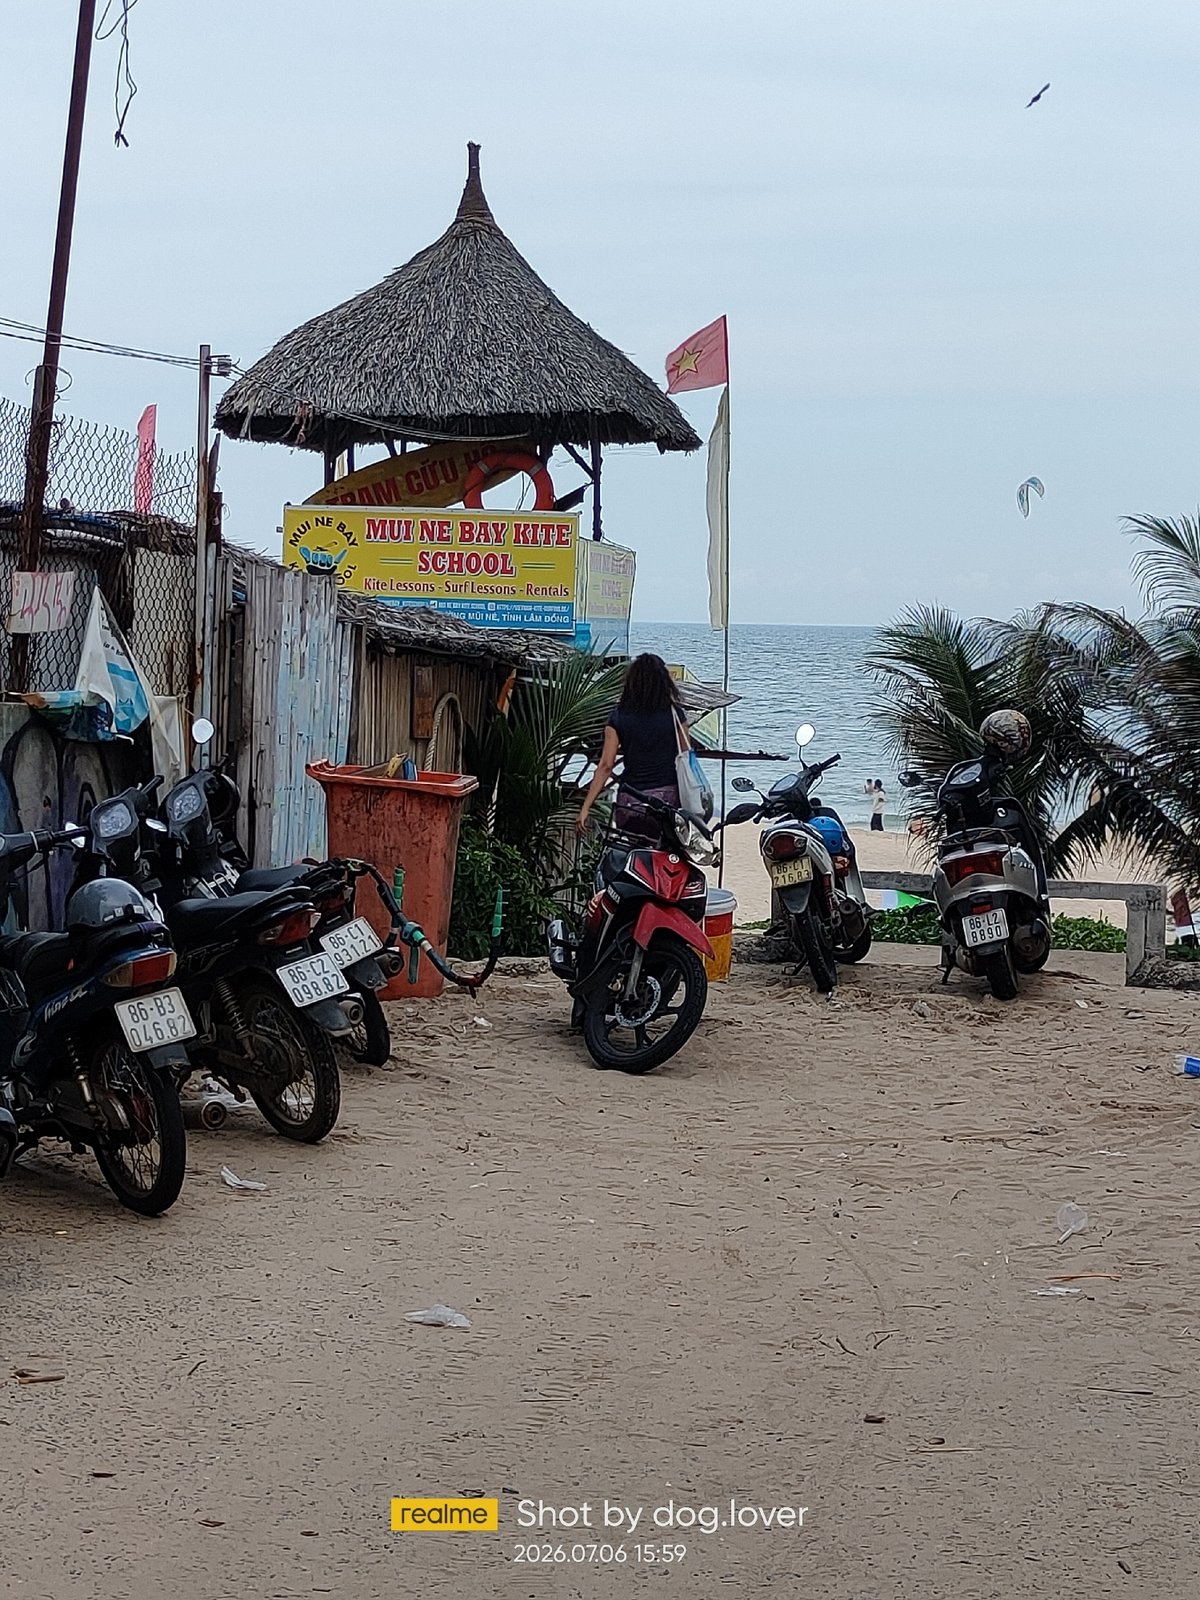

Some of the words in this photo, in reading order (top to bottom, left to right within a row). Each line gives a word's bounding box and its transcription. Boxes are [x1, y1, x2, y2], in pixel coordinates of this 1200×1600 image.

[289, 520, 311, 547] MUI
[315, 516, 333, 527] NE
[336, 521, 359, 547] BAY
[366, 518, 413, 542] MUI
[419, 520, 452, 544] NE
[459, 521, 507, 545] BAY
[513, 523, 570, 546] KITE
[418, 551, 514, 575] SCHOOL
[364, 578, 388, 592] Kite
[390, 579, 435, 593] Lessons
[444, 581, 470, 594] Surf
[471, 582, 517, 596] Lessons
[526, 584, 570, 597] Rentals
[969, 913, 1000, 930] 86-L2
[971, 925, 1002, 943] 8890
[328, 923, 365, 949] 86-C1
[333, 934, 378, 966] 931.21
[287, 958, 330, 984] 86-C2
[292, 973, 345, 1003] 098.82
[128, 994, 176, 1023] 86-B3
[130, 1014, 191, 1047] 046.82
